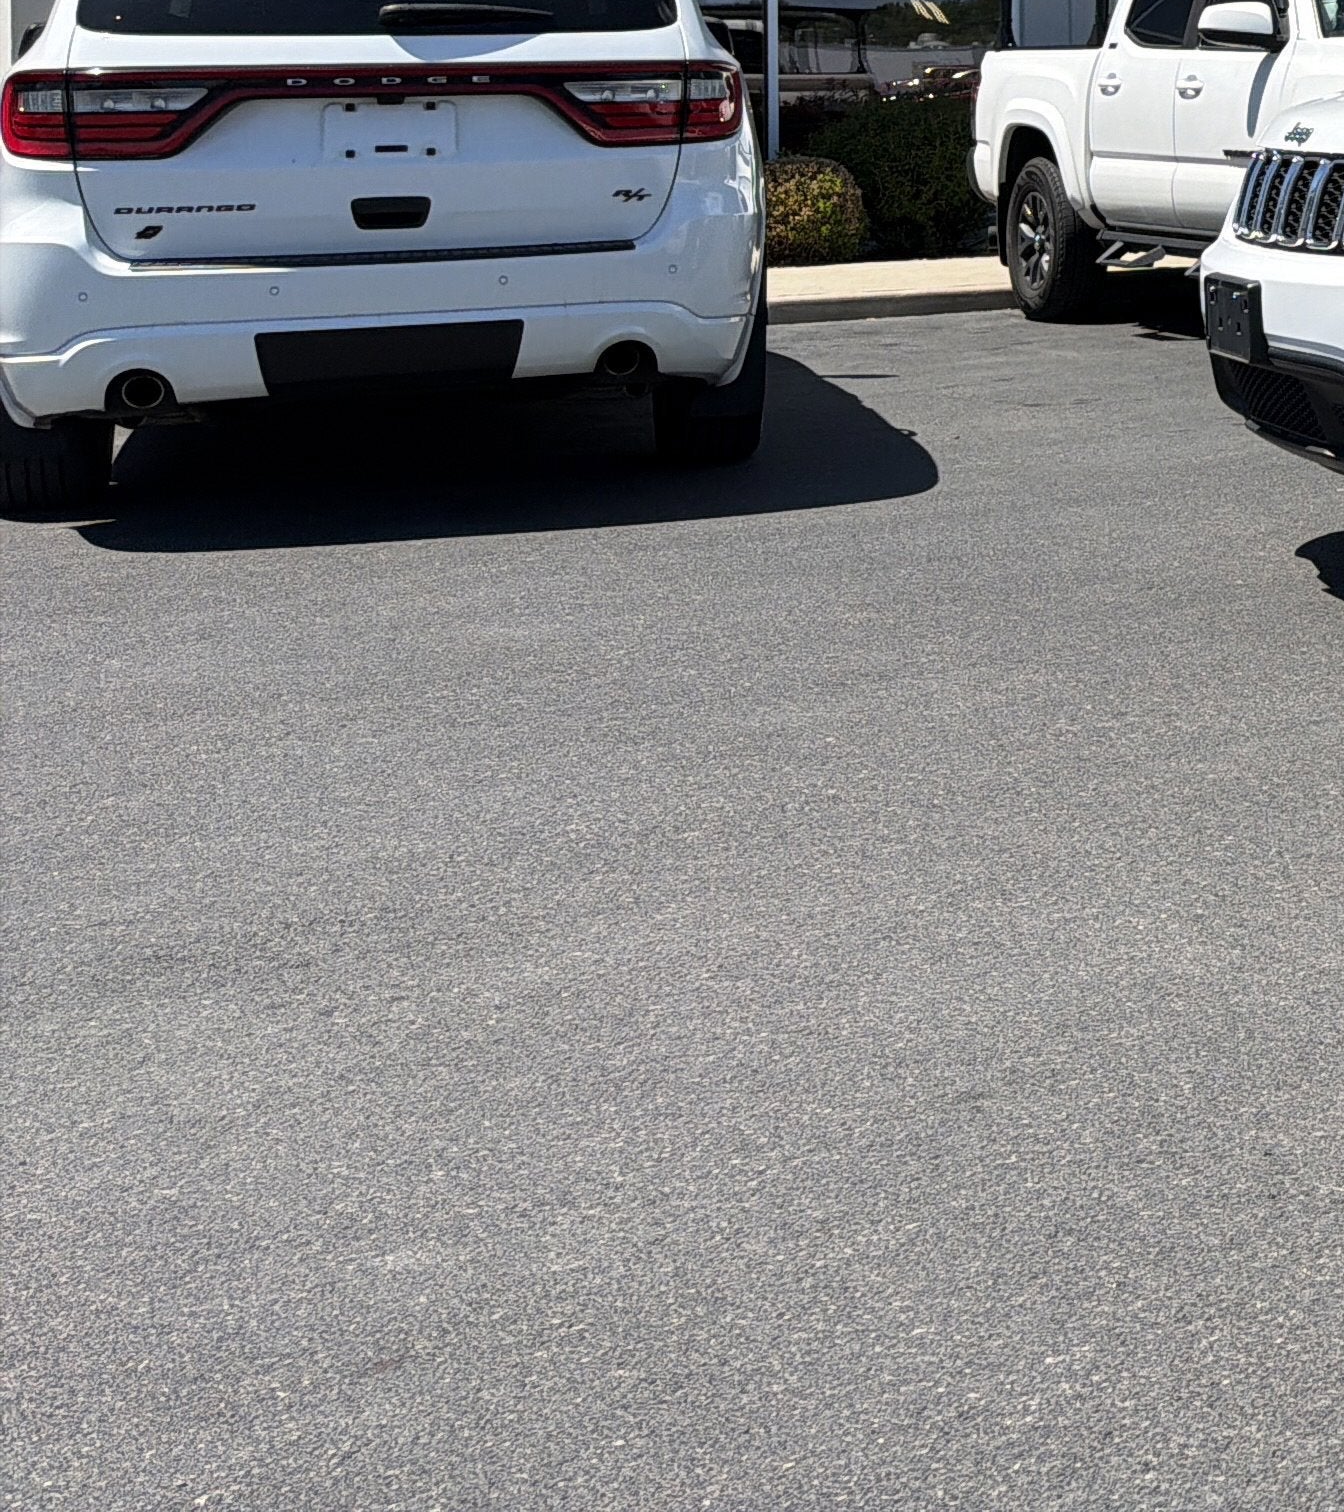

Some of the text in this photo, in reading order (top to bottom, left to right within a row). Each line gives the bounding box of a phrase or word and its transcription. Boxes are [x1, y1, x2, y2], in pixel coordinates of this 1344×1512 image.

[286, 74, 491, 86] DODGE
[612, 187, 652, 203] R/T
[113, 203, 257, 216] DURANGO
